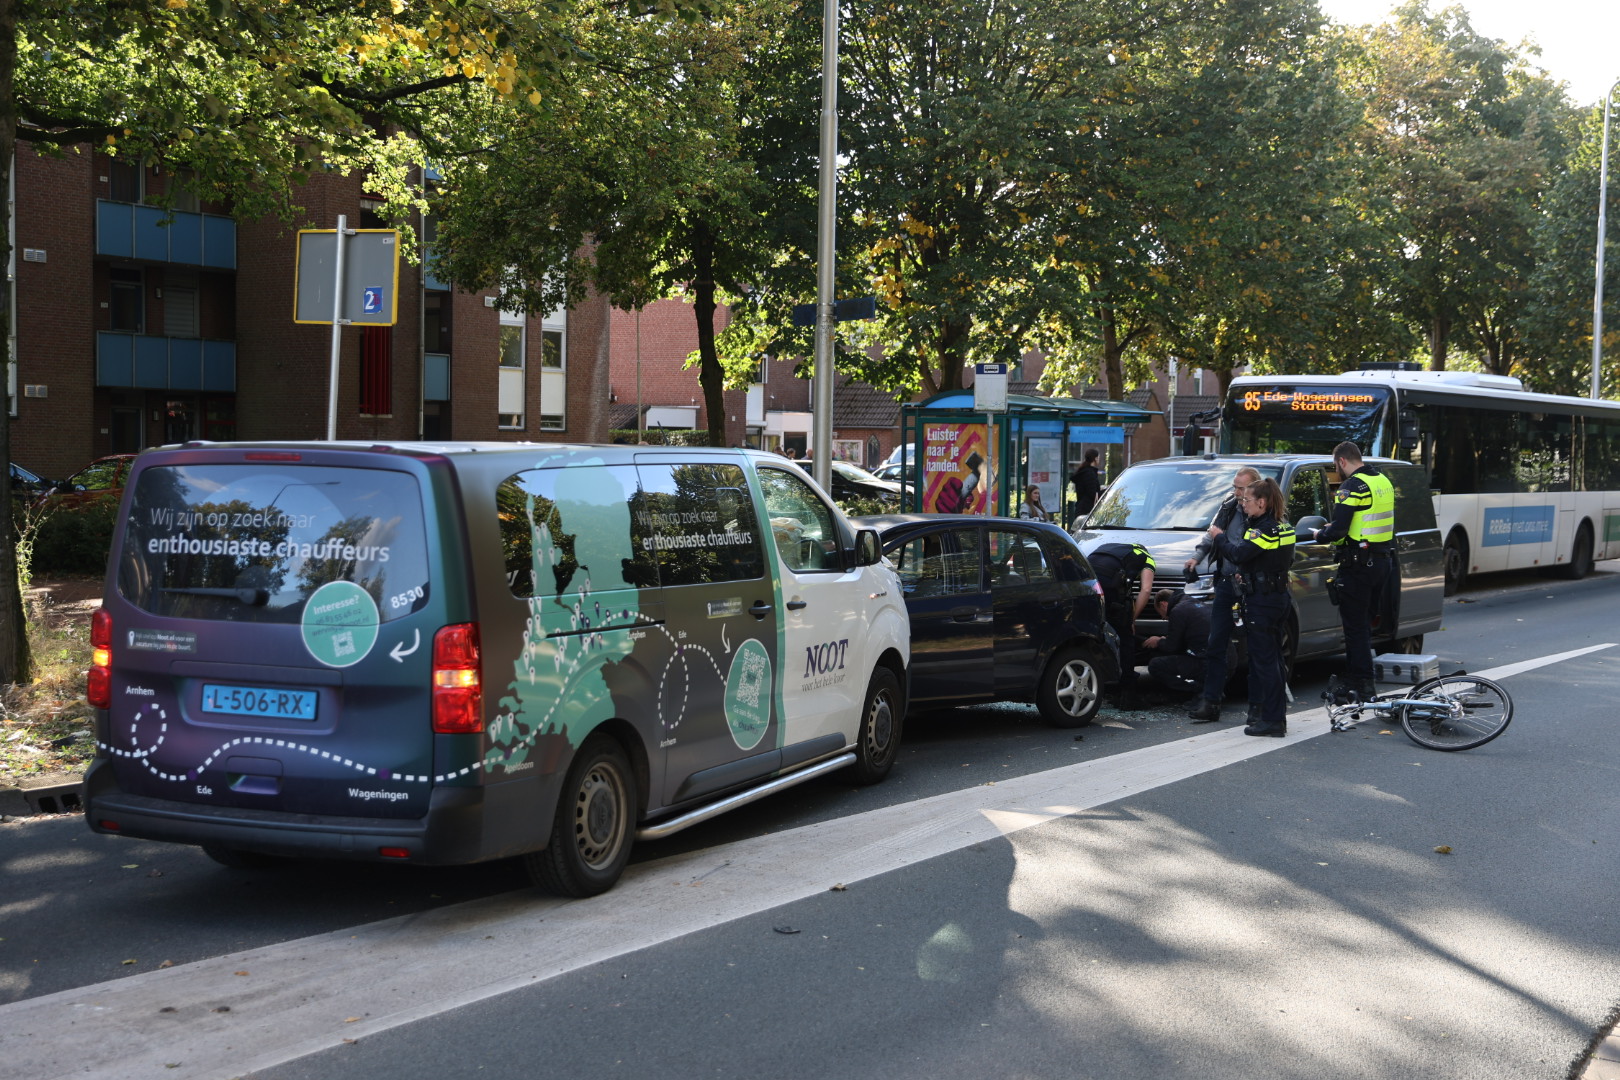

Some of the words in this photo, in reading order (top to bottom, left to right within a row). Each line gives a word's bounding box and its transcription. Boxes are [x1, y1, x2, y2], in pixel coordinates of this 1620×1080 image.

[365, 291, 374, 310] 2
[1244, 391, 1261, 411] 85
[1263, 391, 1373, 403] Ede-Wageningen
[1291, 401, 1343, 411] Station
[926, 427, 959, 442] Luister
[926, 445, 945, 457] naar
[949, 444, 960, 460] je
[926, 458, 960, 473] handen.
[150, 508, 174, 531] Wij
[177, 510, 203, 532] zijn
[208, 514, 229, 533] op
[234, 508, 272, 528] zoek
[278, 513, 315, 528] naar
[636, 510, 652, 527] Wij
[668, 513, 680, 526] op
[682, 507, 701, 523] zoek
[701, 510, 718, 522] naar
[148, 533, 271, 557] enthousiaste
[276, 537, 390, 563] chauffeurs
[642, 530, 705, 550] enthousiaste
[707, 527, 752, 547] chauffeurs
[313, 594, 359, 615] Interesse?
[391, 585, 424, 609] 8530
[626, 630, 646, 641] Zutphen
[678, 630, 687, 639] Ede
[803, 638, 849, 679] NOOT
[125, 685, 155, 698] Arnhem
[213, 688, 304, 715] L-506-RX
[503, 760, 534, 775] Apeldoorn
[196, 784, 212, 796] Ede
[349, 787, 409, 804] Wageningen
